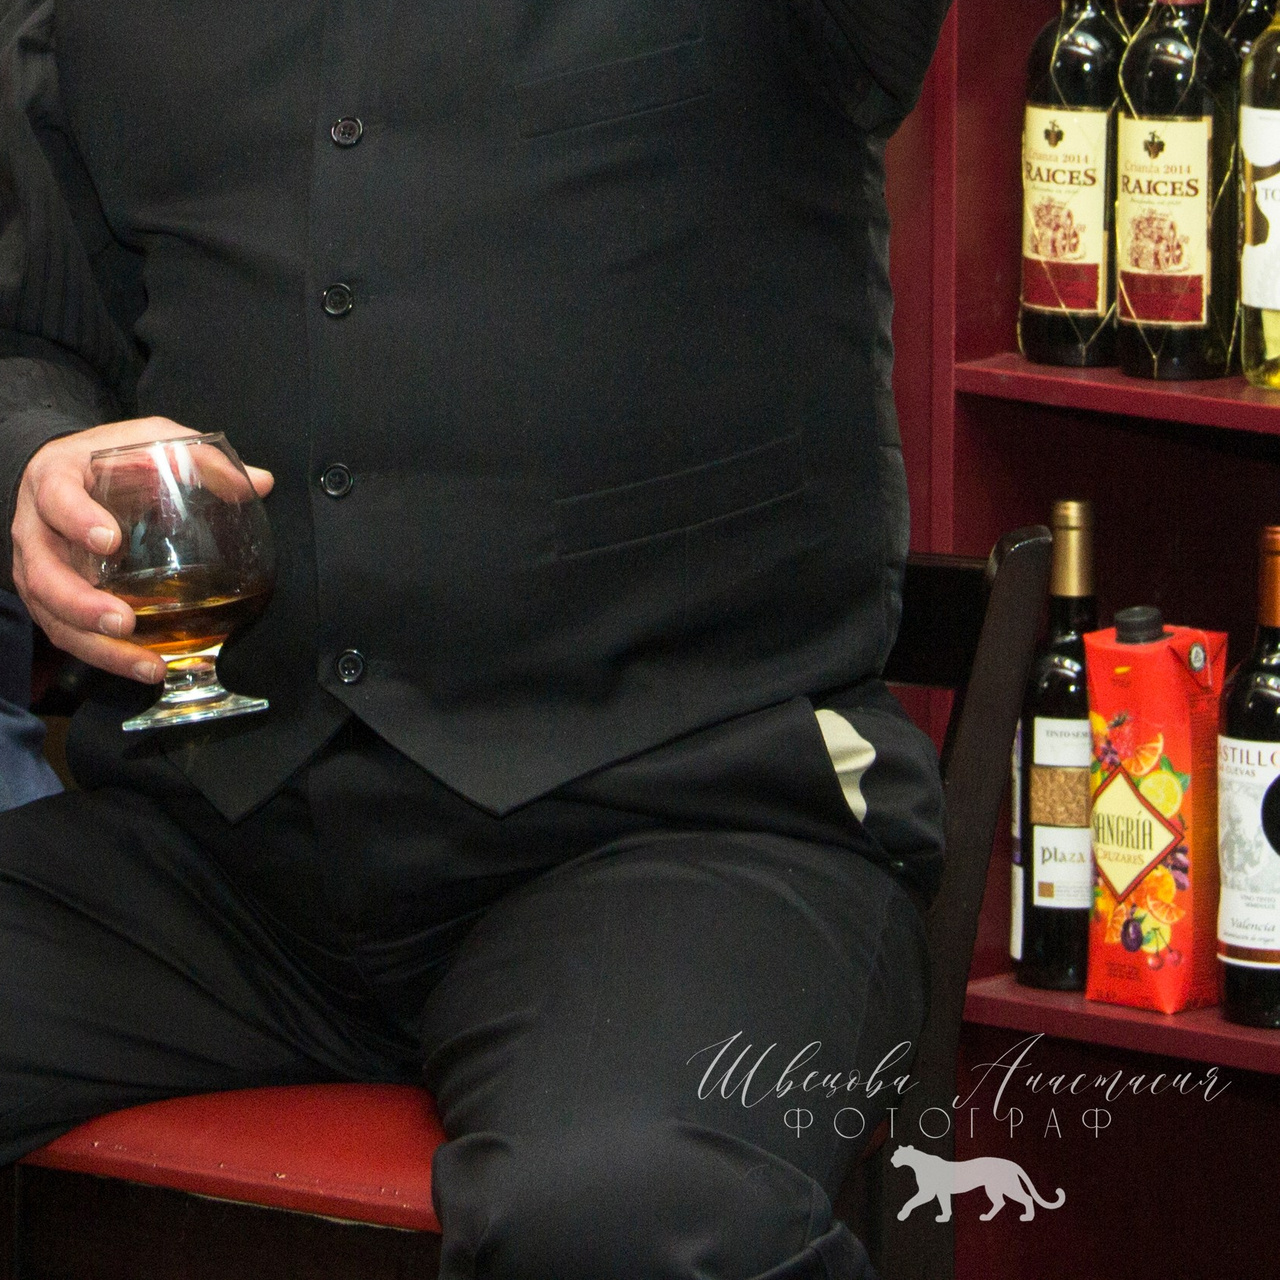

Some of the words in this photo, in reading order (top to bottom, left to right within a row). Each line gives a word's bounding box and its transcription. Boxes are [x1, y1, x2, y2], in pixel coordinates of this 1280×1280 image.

[1025, 160, 1097, 187] RAICES
[1163, 163, 1191, 175] 2014
[1121, 174, 1200, 198] RAICES
[1230, 917, 1276, 933] Valencia
